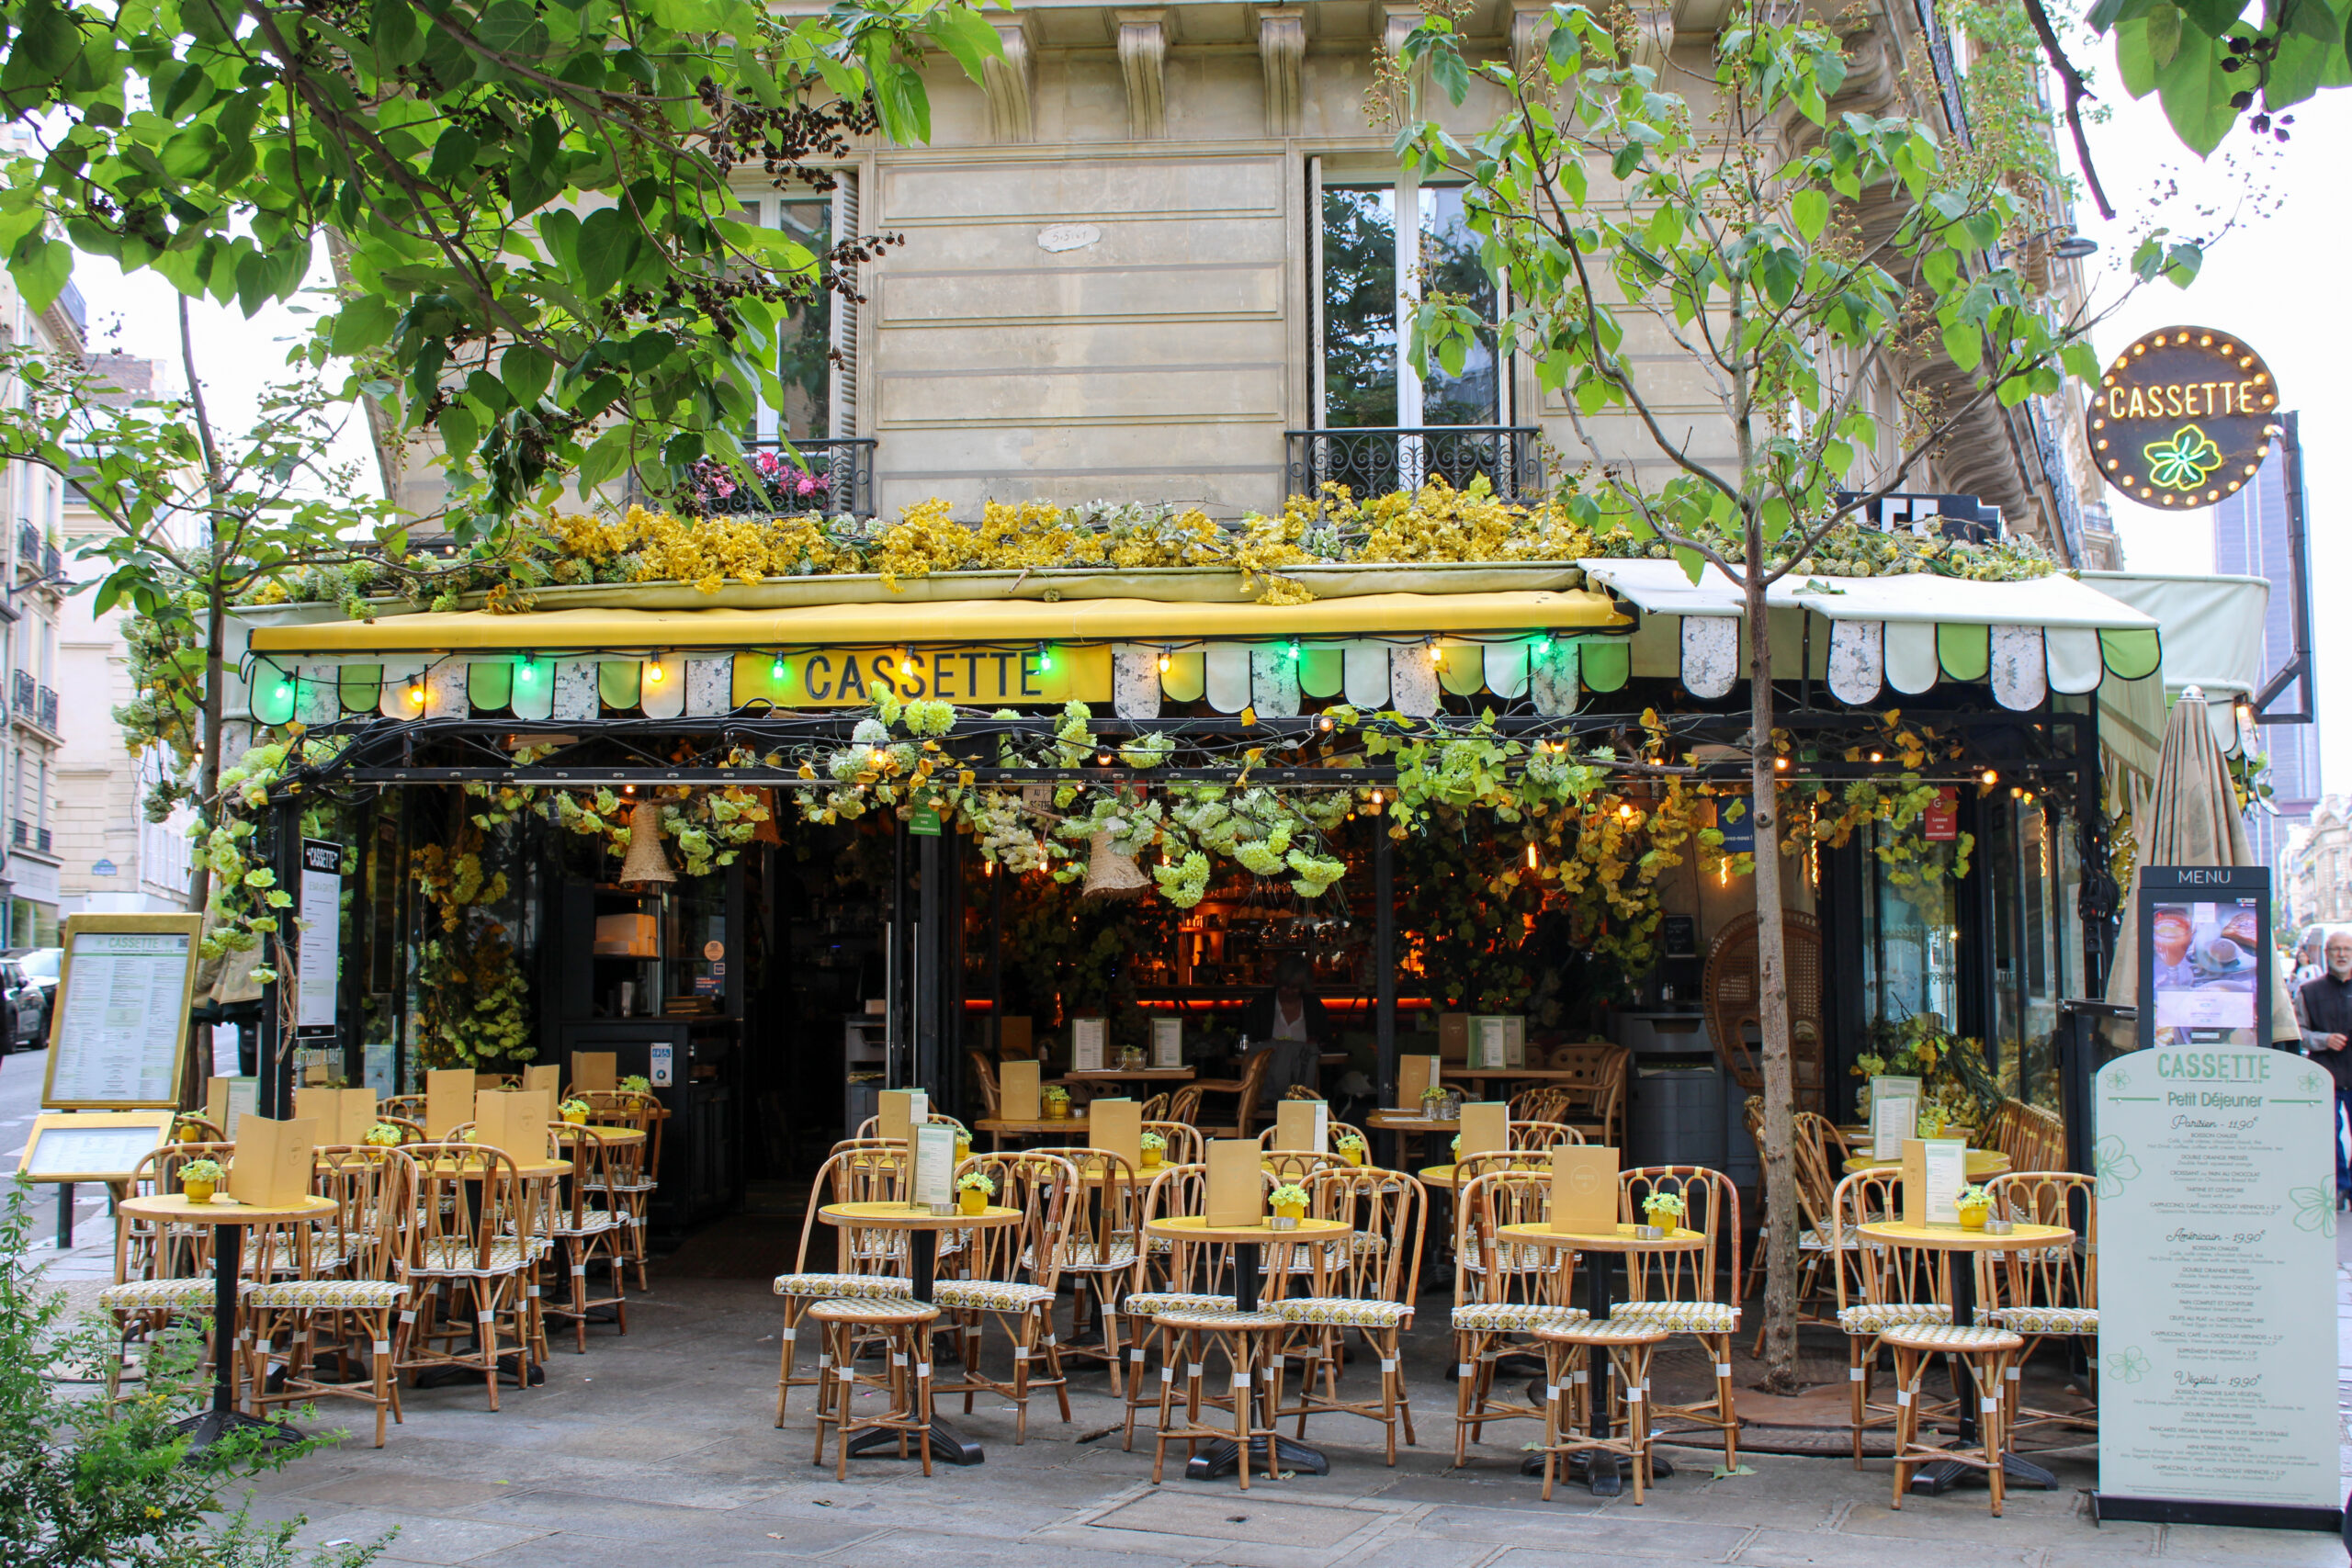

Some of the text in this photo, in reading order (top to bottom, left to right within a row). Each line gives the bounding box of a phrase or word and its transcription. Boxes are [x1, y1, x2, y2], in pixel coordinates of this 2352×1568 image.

[2109, 380, 2256, 419] CASSETTE
[806, 652, 1043, 700] CASSETTE
[2178, 870, 2232, 885] MENU
[108, 937, 159, 948] CASSETTE
[2157, 1053, 2271, 1079] CASSETTE
[2167, 1091, 2263, 1110] Petit Déjeuner
[2170, 1113, 2217, 1130] Parisien
[2165, 1227, 2222, 1243] Américain
[2174, 1371, 2218, 1389] Végétal
